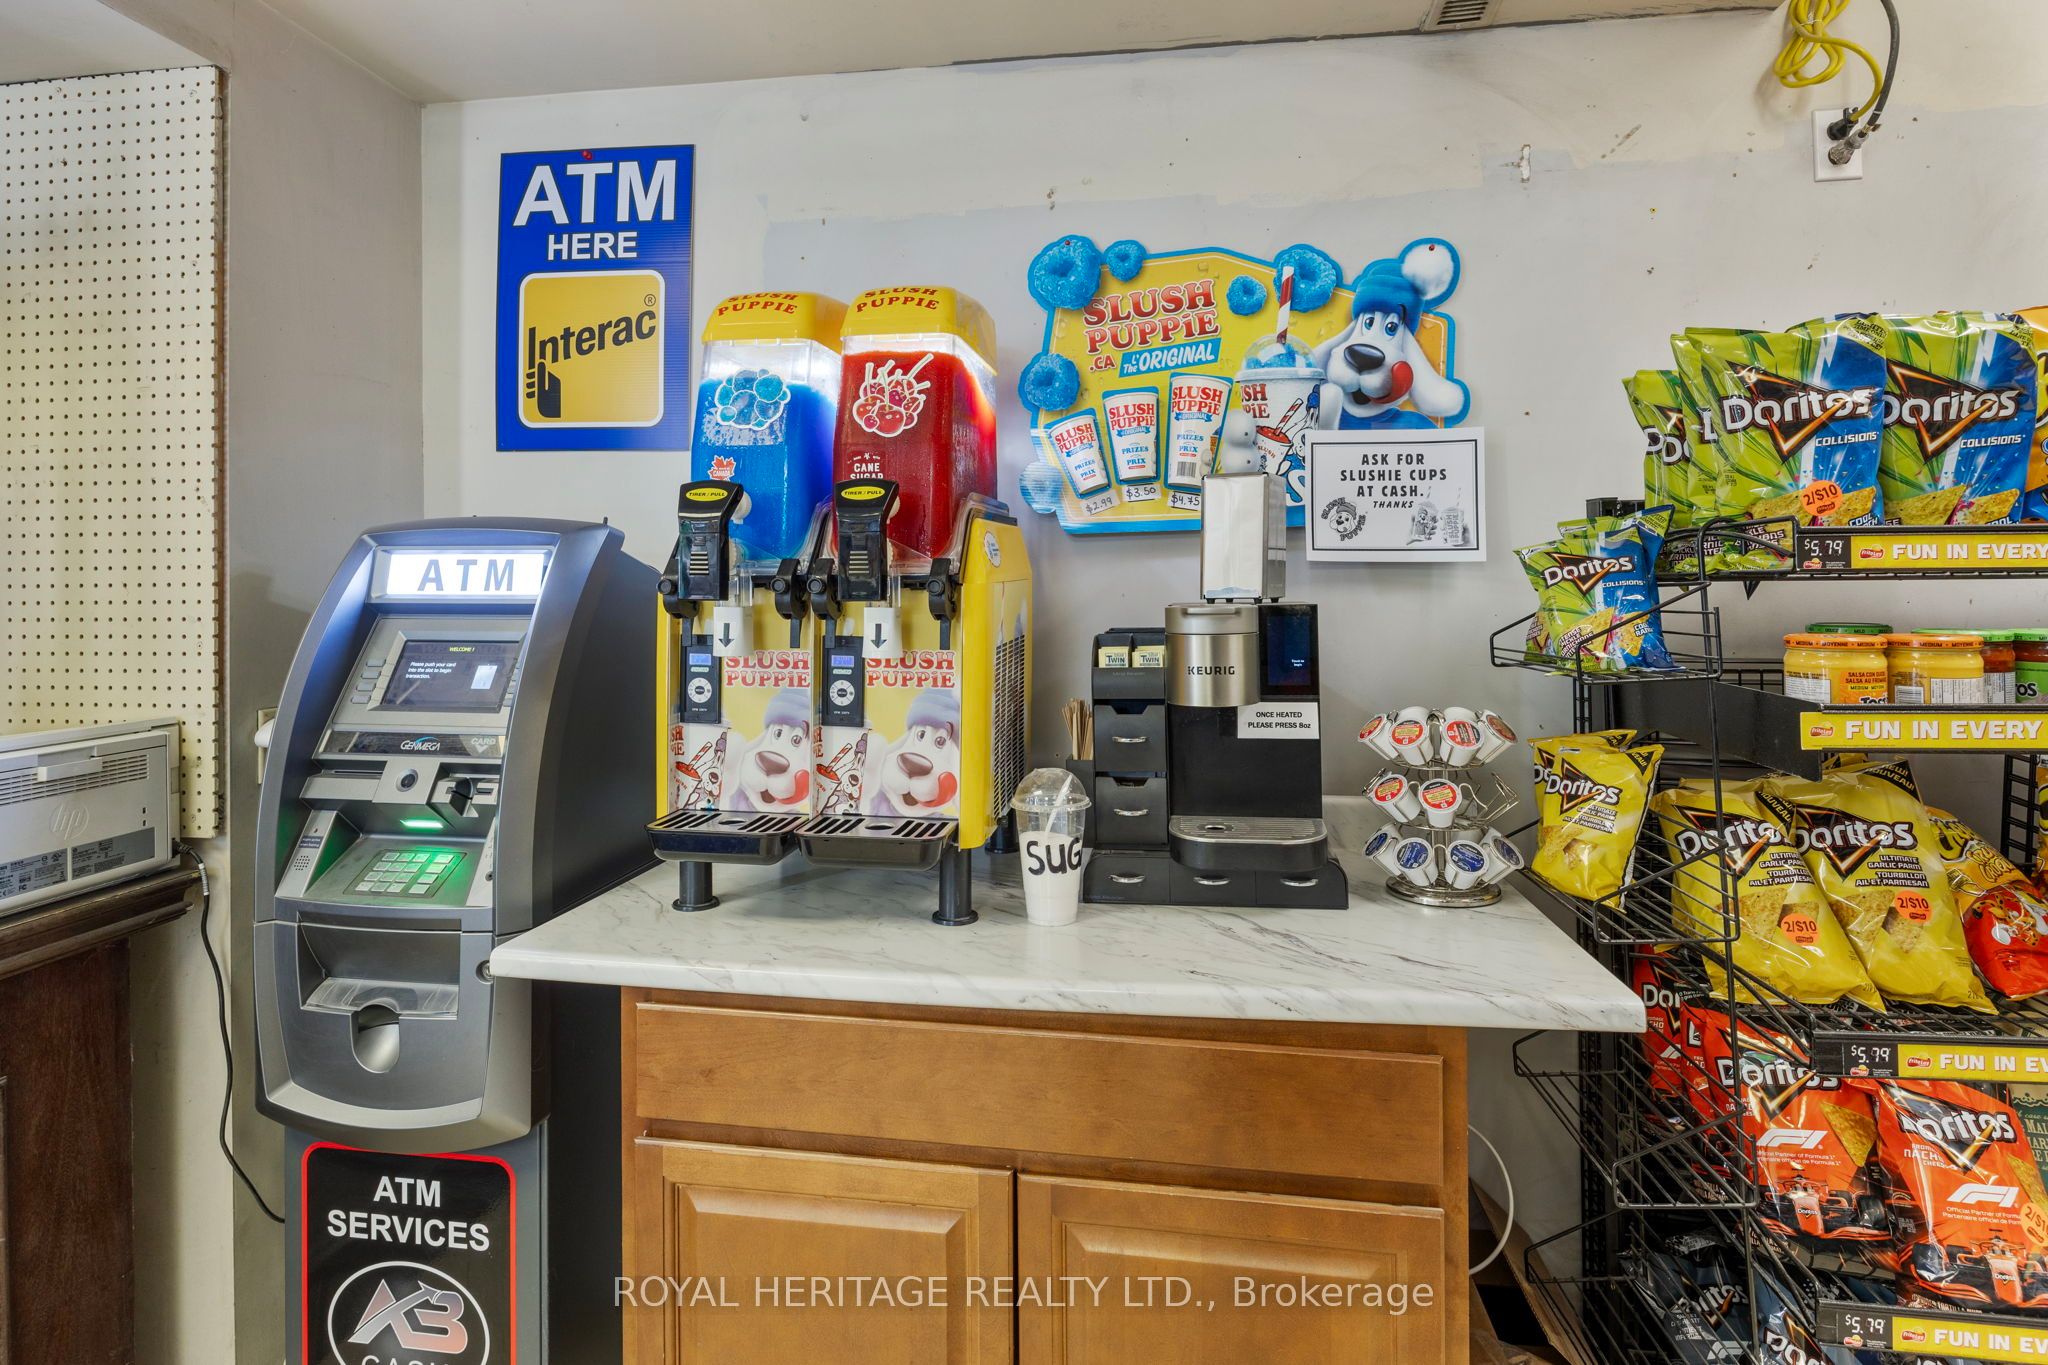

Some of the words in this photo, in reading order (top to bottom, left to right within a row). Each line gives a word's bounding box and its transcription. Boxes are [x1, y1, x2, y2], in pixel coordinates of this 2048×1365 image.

[513, 159, 676, 226] ATM
[547, 231, 638, 260] HERE
[718, 301, 797, 316] PUPPIE
[856, 297, 939, 313] PUPPIE
[1083, 279, 1215, 326] SLUSH
[528, 309, 656, 370] Interac
[1089, 355, 1116, 371] .CA
[1124, 363, 1138, 373] The
[1139, 343, 1215, 370] ORIGINAL
[1172, 386, 1223, 402] SLUSH
[1109, 403, 1155, 419] SLUSH
[1723, 391, 1873, 431] Doritos
[1055, 423, 1093, 445] SLUSH
[1816, 432, 1877, 446] COLLISIONS
[1961, 434, 2022, 448] COLLISIONS
[1122, 446, 1149, 454] PRIZES
[853, 463, 880, 472] CANE
[1361, 453, 1389, 465] ASK
[1397, 453, 1425, 465] FOR
[1340, 469, 1401, 481] SLUSHIE
[1410, 469, 1447, 481] CUPS
[1126, 487, 1156, 500] $3.50
[1357, 486, 1374, 497] AT
[1382, 485, 1424, 497] CASH.
[1803, 484, 1838, 505] 2/$10
[1086, 497, 1113, 514] $2.99
[1171, 494, 1200, 506] $4.75
[1373, 500, 1414, 508] THANKS
[1804, 539, 1842, 556] $5.79
[1893, 544, 1938, 560] FUN
[1947, 544, 1969, 560] IN
[1978, 542, 2048, 560] EVERY
[418, 559, 514, 592] ATM
[1544, 556, 1634, 587] Doritos
[1602, 580, 1644, 588] COLLISIONS
[725, 650, 810, 671] SLUSH
[866, 650, 955, 671] SLUSH
[1106, 655, 1125, 663] TWIN
[1140, 655, 1160, 663] TWIN
[1187, 666, 1235, 675] KEURIG
[1846, 720, 1900, 739] FUN
[1912, 720, 1940, 739] IN
[1951, 720, 2043, 739] EVERY
[401, 740, 441, 751] GENMEGA
[471, 738, 496, 746] CARD
[1546, 775, 1620, 804] Doritos
[1678, 821, 1785, 860] Dorito
[1027, 837, 1081, 876] SUG
[1877, 872, 1926, 880] TOURBILLON
[1898, 897, 1929, 910] 2/$10
[1784, 920, 1817, 933] 2/$10
[1851, 1046, 1890, 1064] $5.79
[1939, 1054, 1985, 1070] FUN
[1994, 1056, 2017, 1072] IN
[1756, 1129, 1828, 1149] F1
[373, 1176, 441, 1208] ATM
[1947, 1183, 2019, 1208] F1
[1943, 1212, 1977, 1221] Partenaire
[327, 1209, 490, 1252] SERVICES
[1845, 1315, 1884, 1334] $5.79
[1934, 1328, 1979, 1347] FUN
[1989, 1334, 2010, 1350] IN
